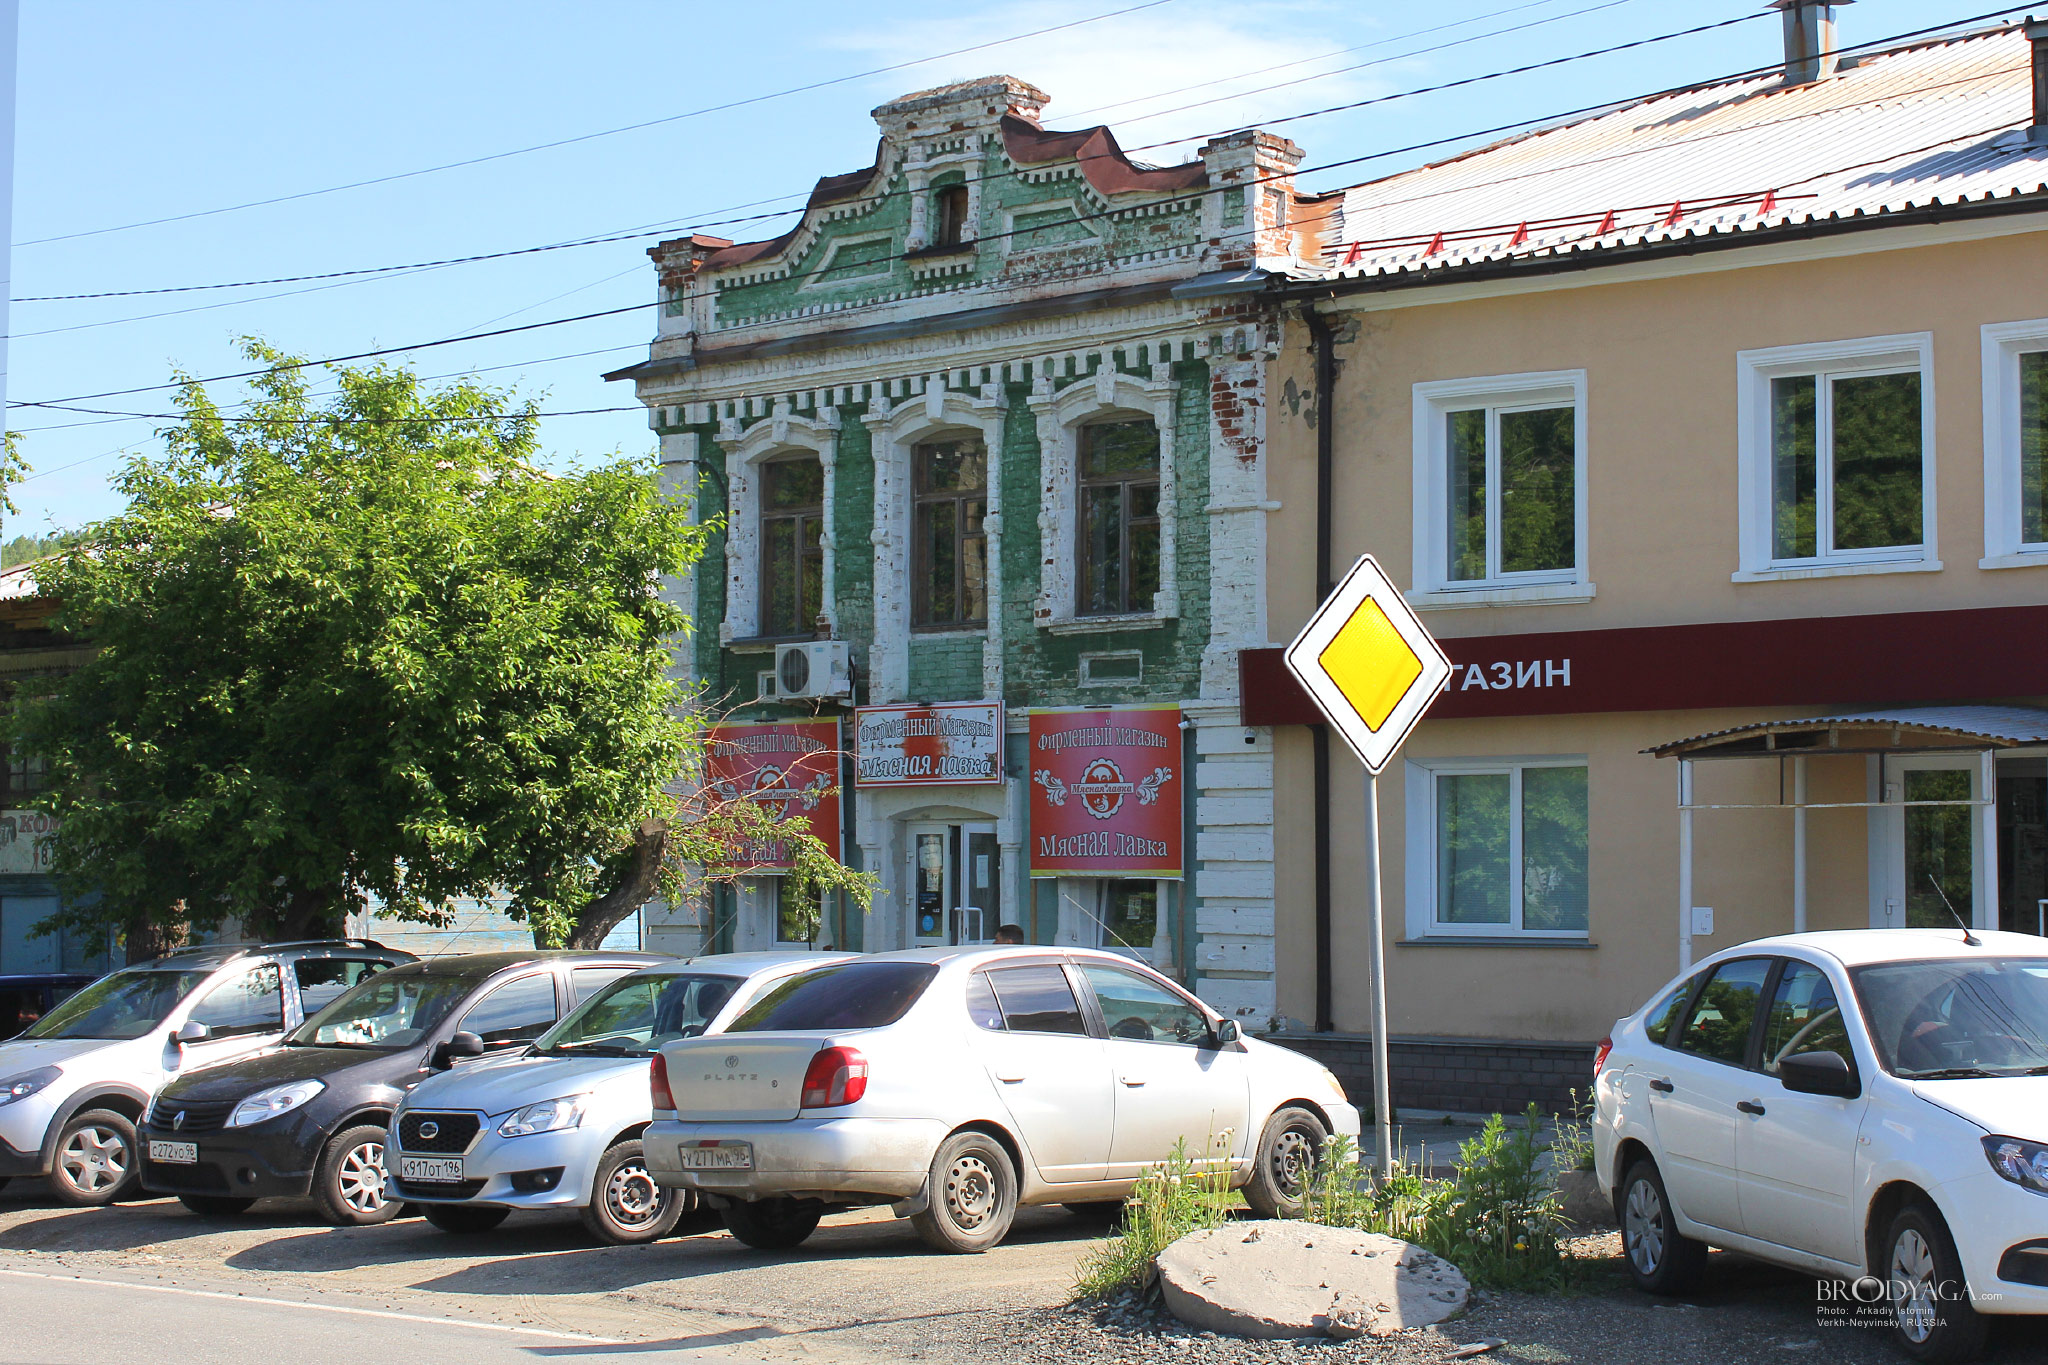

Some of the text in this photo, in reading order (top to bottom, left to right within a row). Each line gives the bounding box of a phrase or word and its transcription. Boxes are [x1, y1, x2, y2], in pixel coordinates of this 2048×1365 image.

[860, 710, 994, 745] Фирменный магазин
[1037, 719, 1168, 754] Фирменный магазин
[861, 754, 992, 778] Мясная лавка
[1072, 784, 1132, 793] Мясная лавка
[1039, 831, 1168, 857] Мясная лавка
